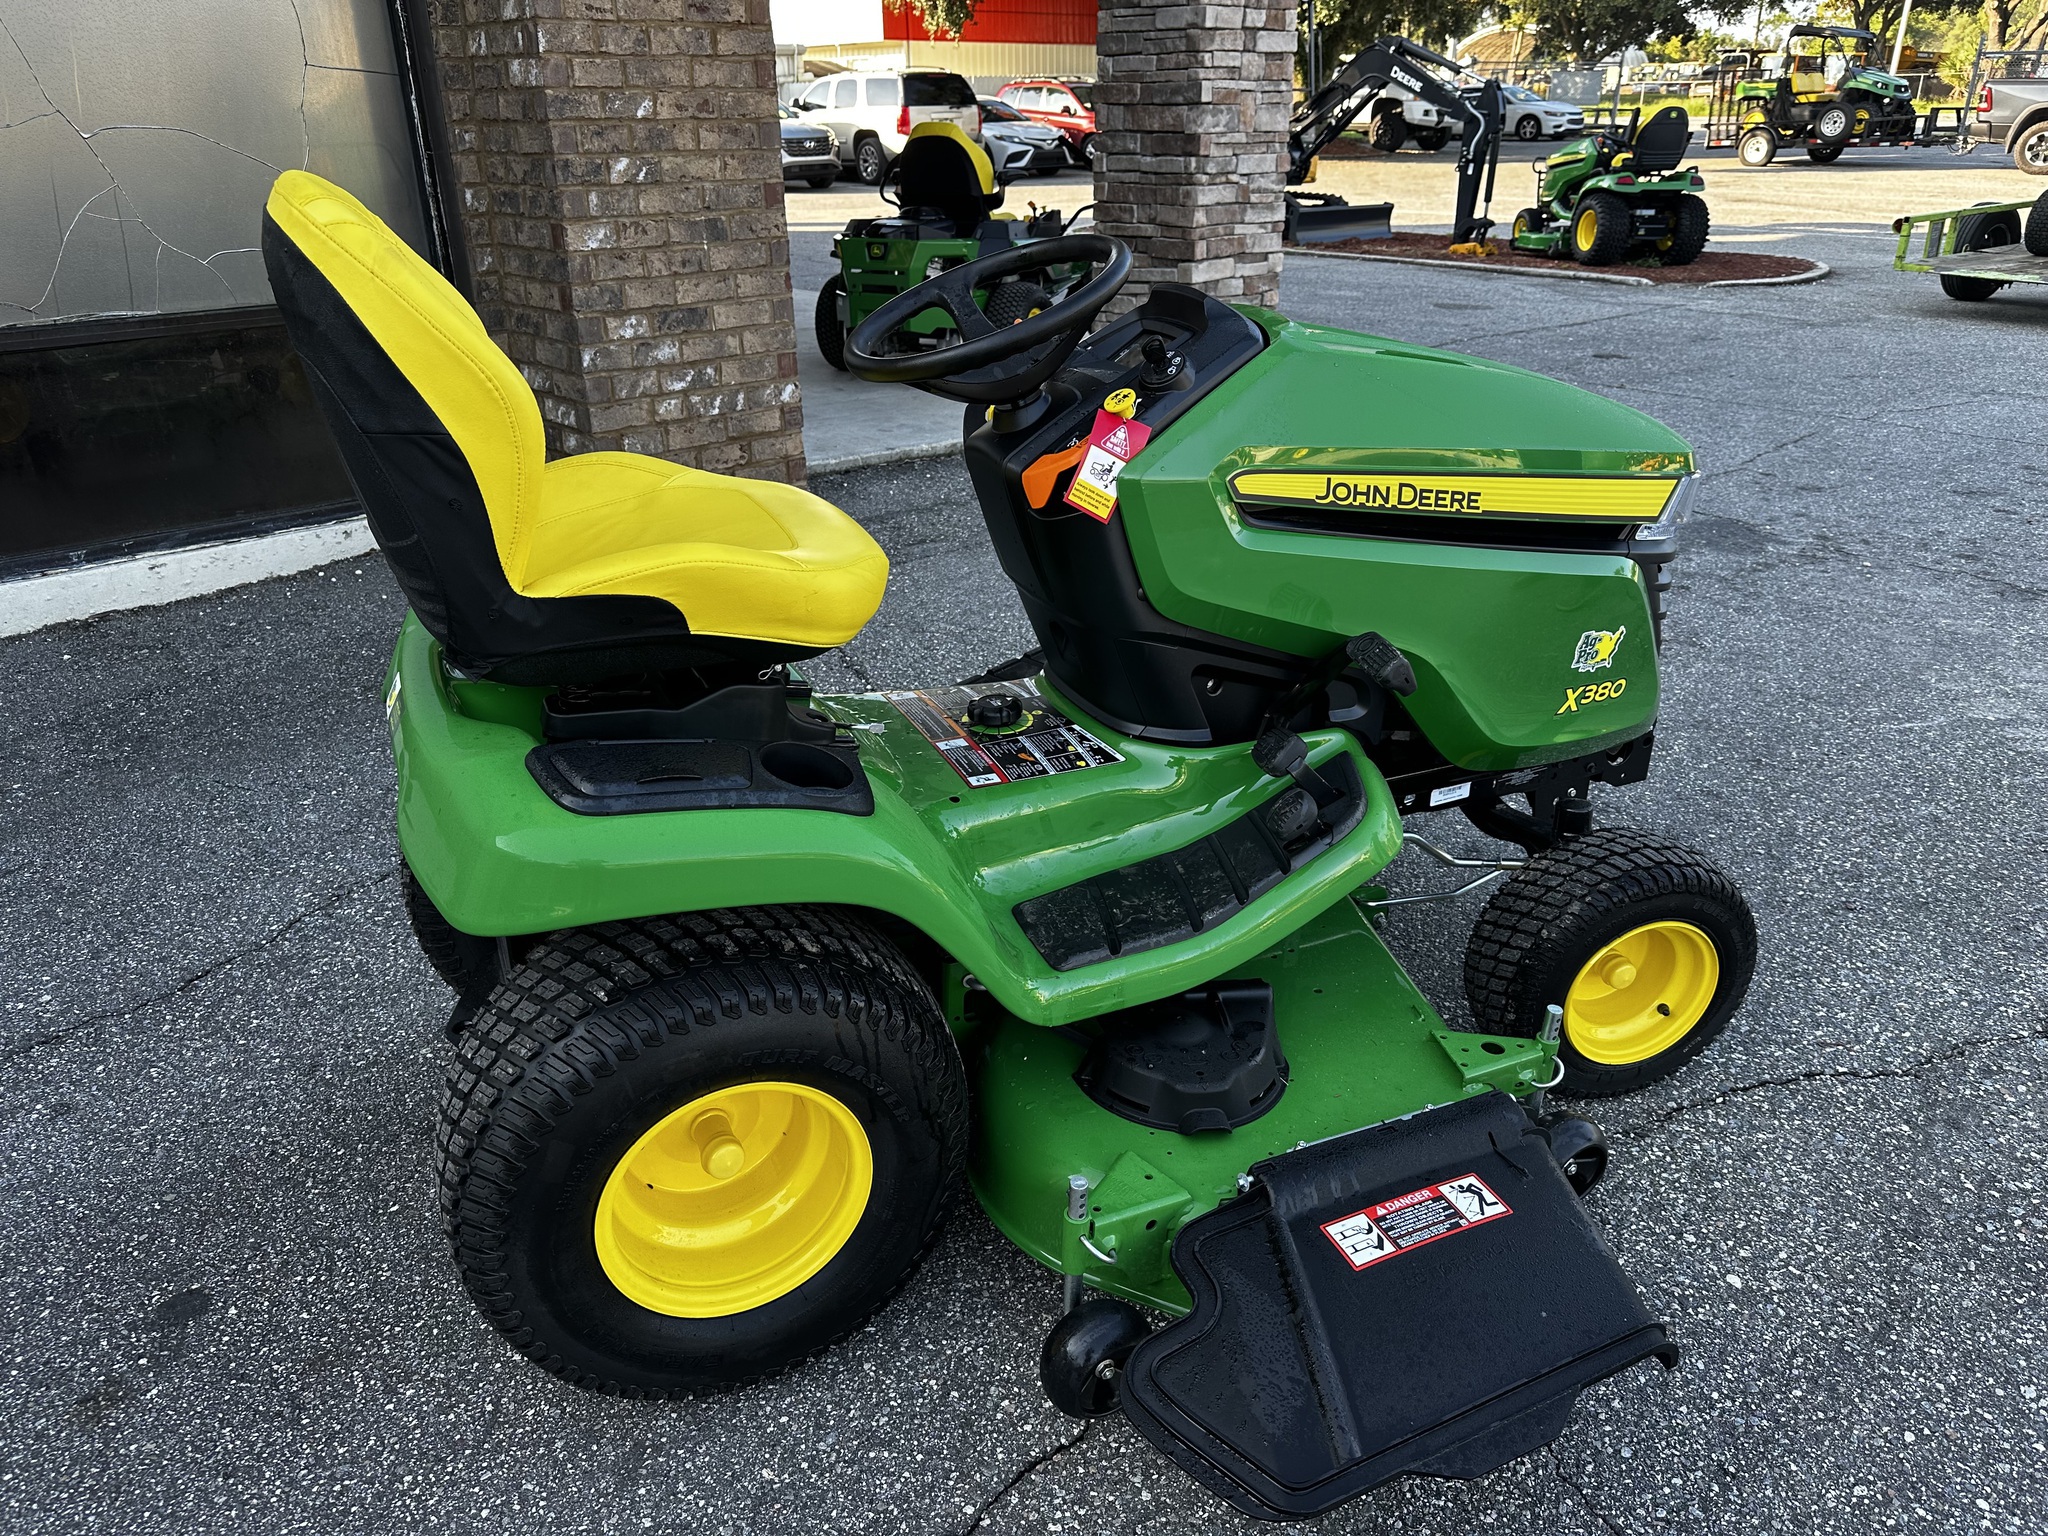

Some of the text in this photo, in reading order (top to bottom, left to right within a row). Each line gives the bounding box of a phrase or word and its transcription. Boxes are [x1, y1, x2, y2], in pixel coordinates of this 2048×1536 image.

[1390, 66, 1423, 92] DEERE
[1110, 435, 1126, 448] SAFETY
[1316, 477, 1482, 512] JOHN DEERE
[1575, 649, 1598, 664] Pro
[1554, 677, 1627, 716] X380
[1692, 898, 1734, 924] TURF
[738, 1048, 911, 1123] TURF MASTER
[1386, 1190, 1432, 1210] DANGER
[1386, 1200, 1433, 1218] ROTATING BLADE
[1394, 1209, 1443, 1228] THROWN OBJECTS
